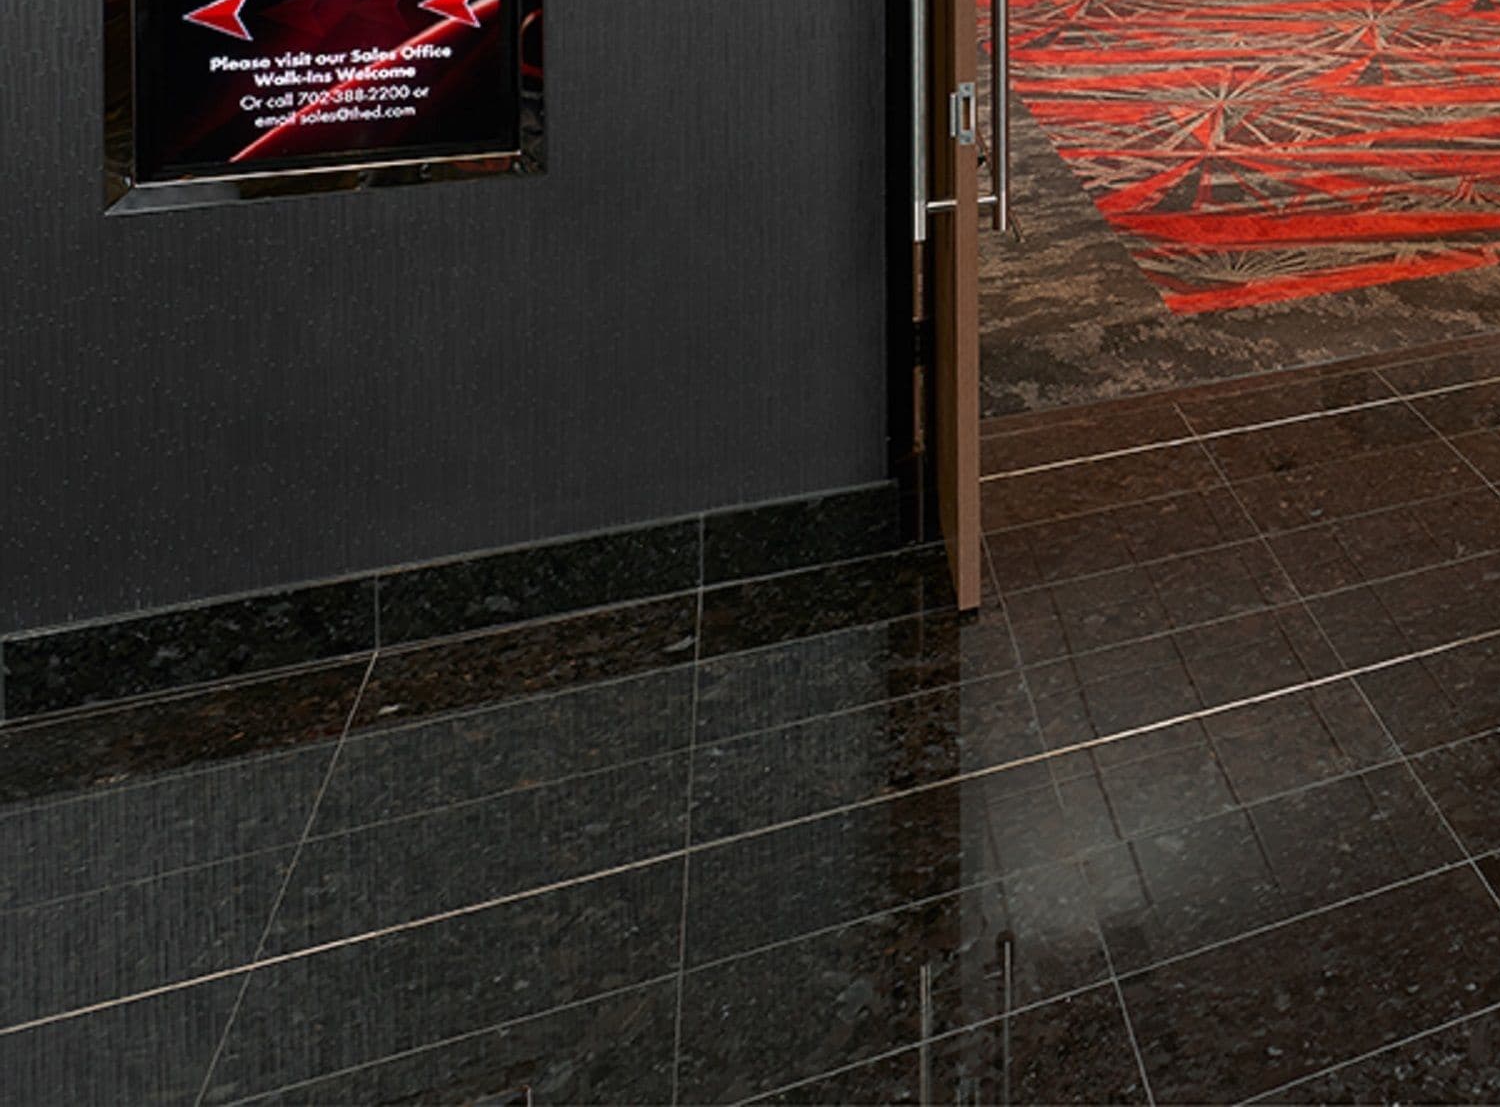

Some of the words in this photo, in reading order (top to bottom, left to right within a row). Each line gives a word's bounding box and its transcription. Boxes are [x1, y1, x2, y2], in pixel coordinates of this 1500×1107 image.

[210, 56, 271, 72] Please
[274, 52, 311, 68] visit
[314, 54, 348, 65] our
[350, 48, 397, 63] Sales
[401, 45, 452, 60] Office
[335, 66, 416, 82] Welcome
[239, 96, 263, 110] Or
[266, 93, 294, 108] call
[412, 87, 430, 98] or
[254, 111, 298, 128] email
